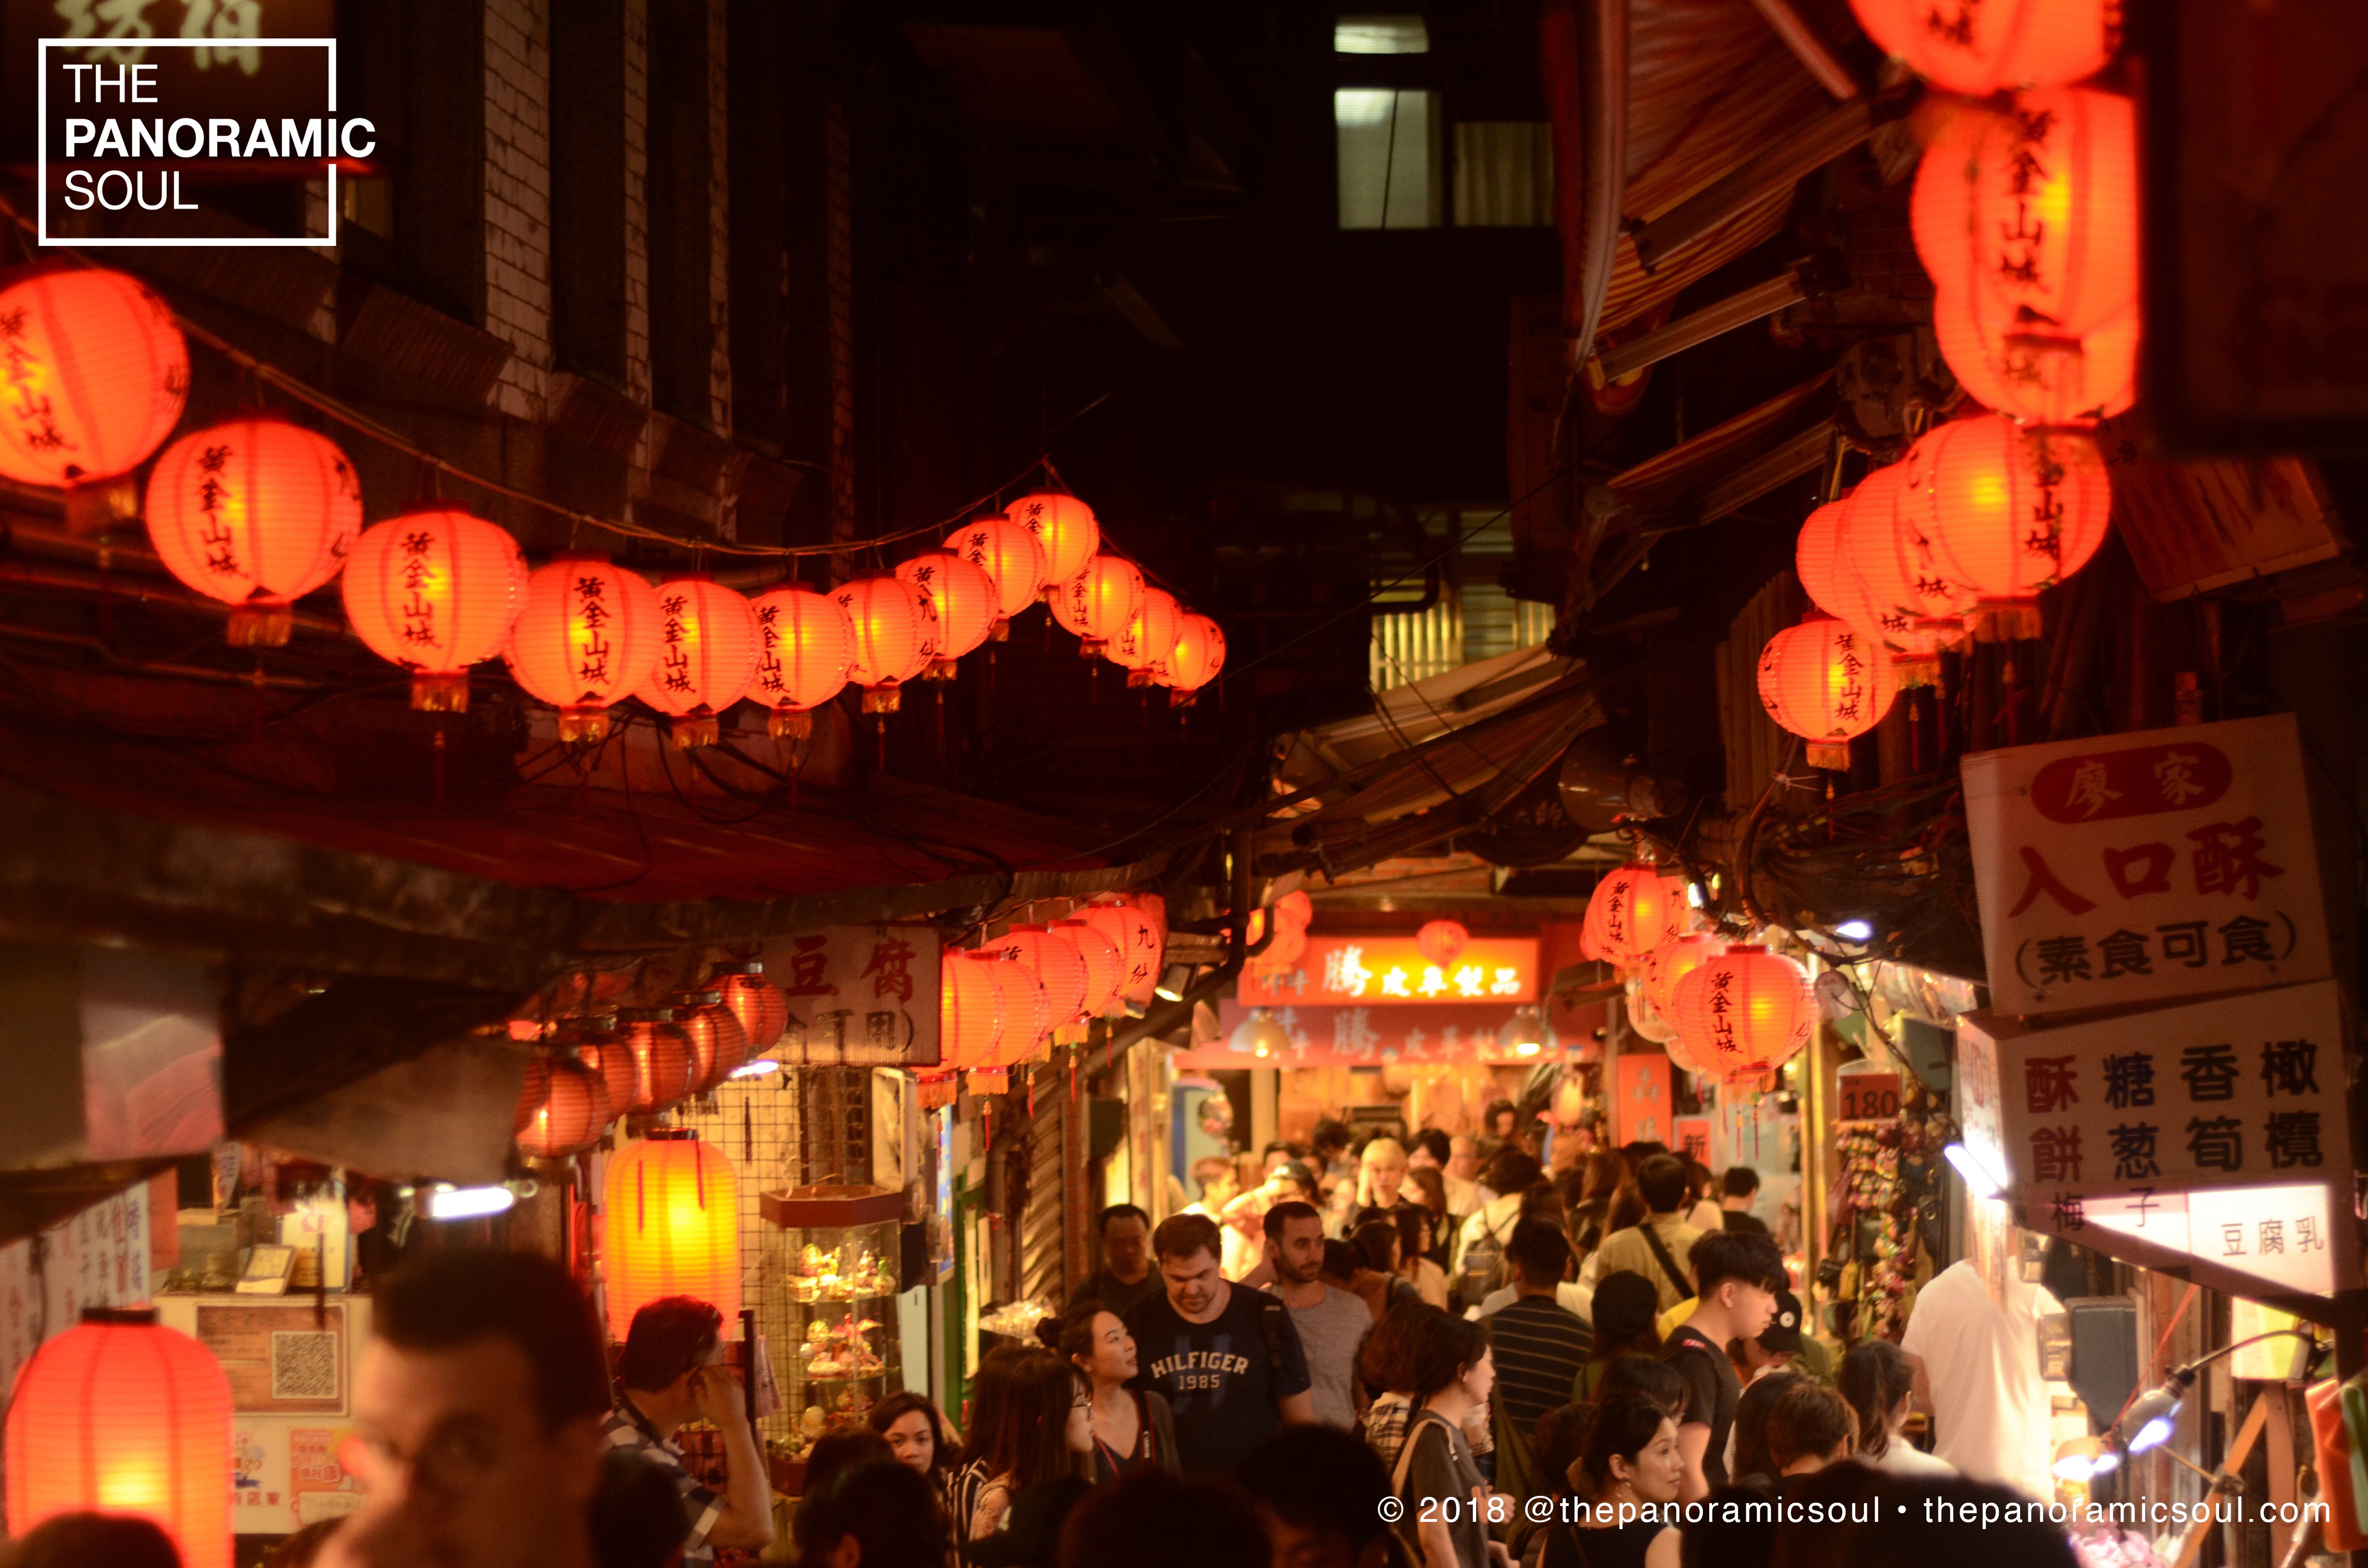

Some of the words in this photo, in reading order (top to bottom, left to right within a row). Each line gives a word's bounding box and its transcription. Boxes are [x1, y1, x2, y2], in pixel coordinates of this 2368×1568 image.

[399, 532, 443, 649] 黃金山城
[573, 577, 612, 685] 黃金山城
[662, 595, 697, 694] 黃金山城
[759, 605, 791, 693] 黃金山城
[1835, 634, 1864, 722] 黃金山城
[2065, 752, 2206, 818] 廖家
[2009, 816, 2285, 918] 入口酥
[2015, 911, 2297, 989] (素食可食)
[1708, 970, 1744, 1054] 黃金山城
[1844, 1089, 1899, 1119] 180
[2024, 1054, 2084, 1183] 酥餅
[2181, 1044, 2243, 1172] 香筍
[2260, 1039, 2324, 1169] 橄欖
[2051, 1187, 2160, 1233] 梅子
[2220, 1215, 2324, 1257] 豆腐乳
[1150, 1351, 1249, 1379] HILFIGER
[1179, 1374, 1221, 1390] 1985
